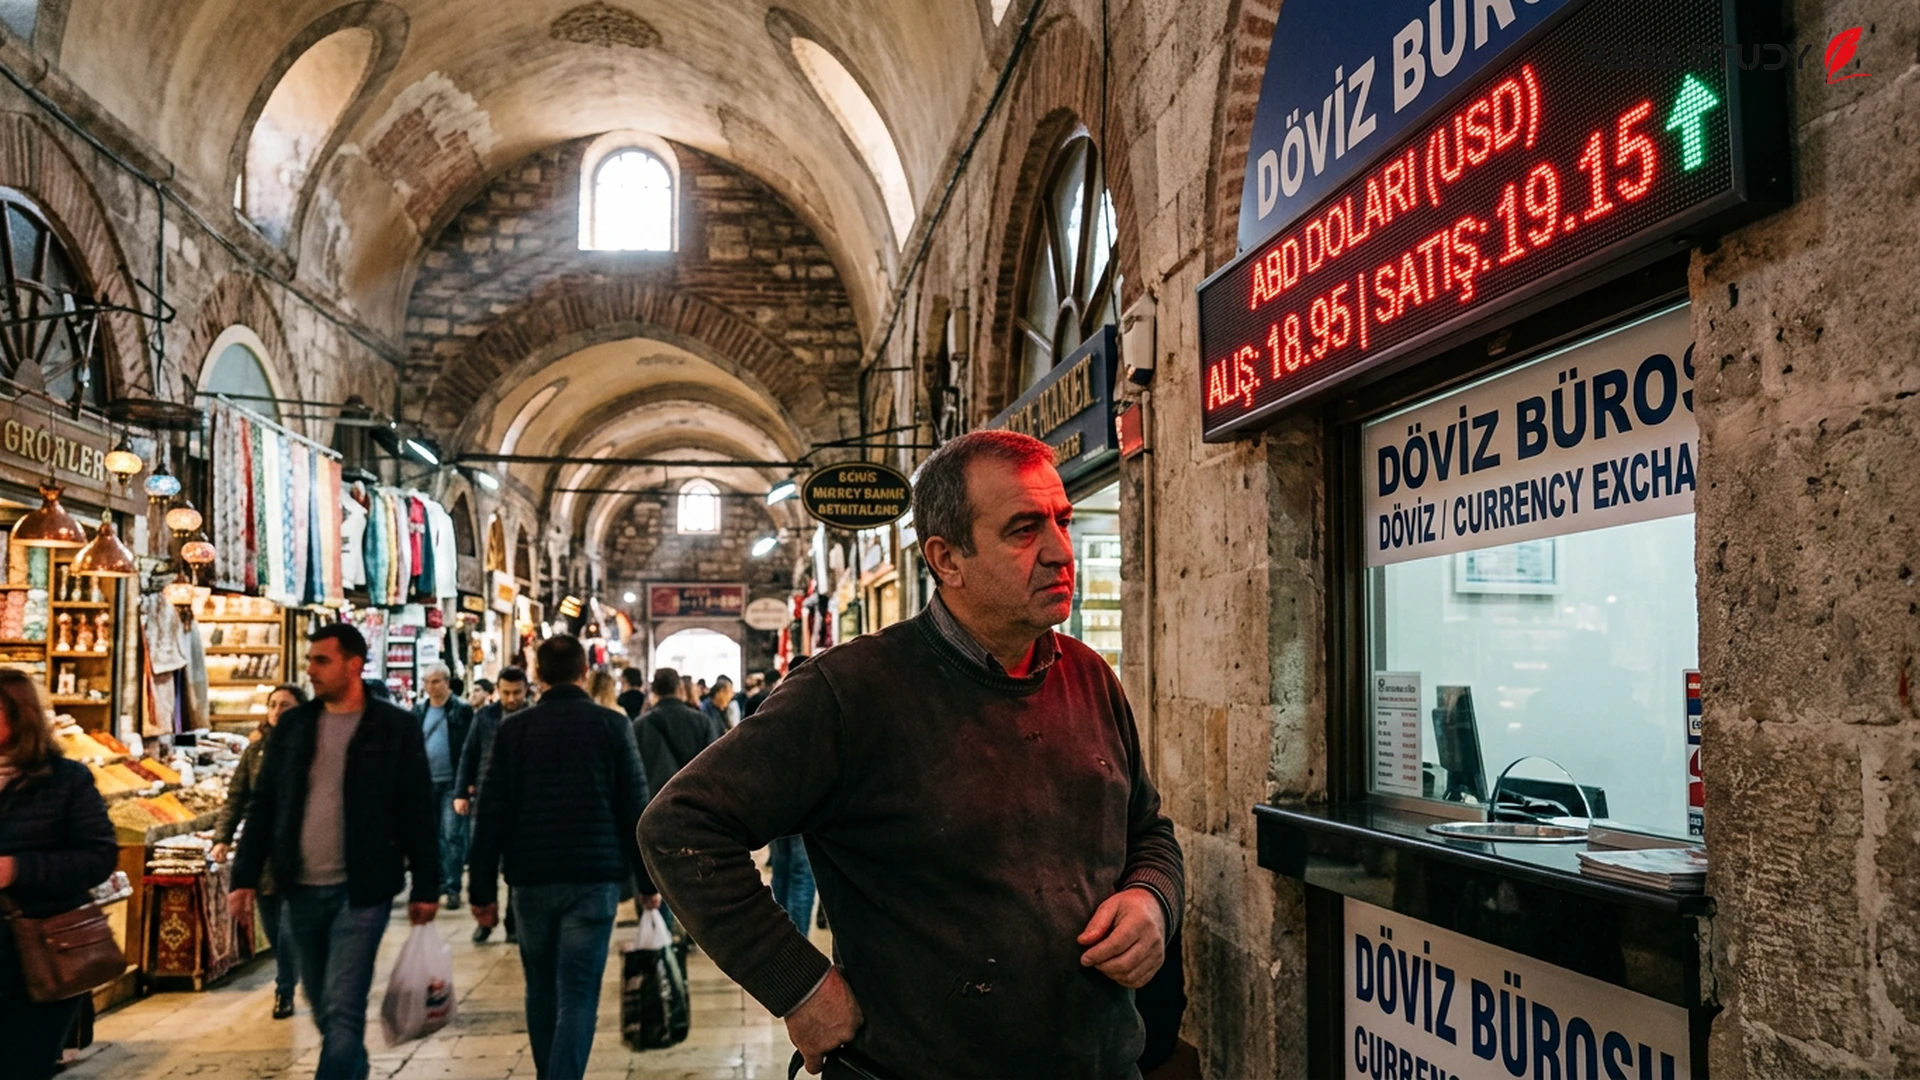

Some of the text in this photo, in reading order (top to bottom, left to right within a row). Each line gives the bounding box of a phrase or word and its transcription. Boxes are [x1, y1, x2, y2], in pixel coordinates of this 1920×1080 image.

[1250, 64, 1539, 311] ABD DOLARI (USD)
[1257, 56, 1377, 221] DÖVİZ
[1208, 345, 1261, 411] ALIŞ:
[1267, 283, 1351, 379] 18.95
[1375, 216, 1490, 323] SATIŞ:
[1496, 100, 1657, 264] 19.15
[1378, 404, 1500, 497] DÖVİZ
[1379, 496, 1436, 551] DÖVİZ
[1453, 467, 1584, 536] CURRENCY
[1355, 925, 1457, 1046] DÖVİZ
